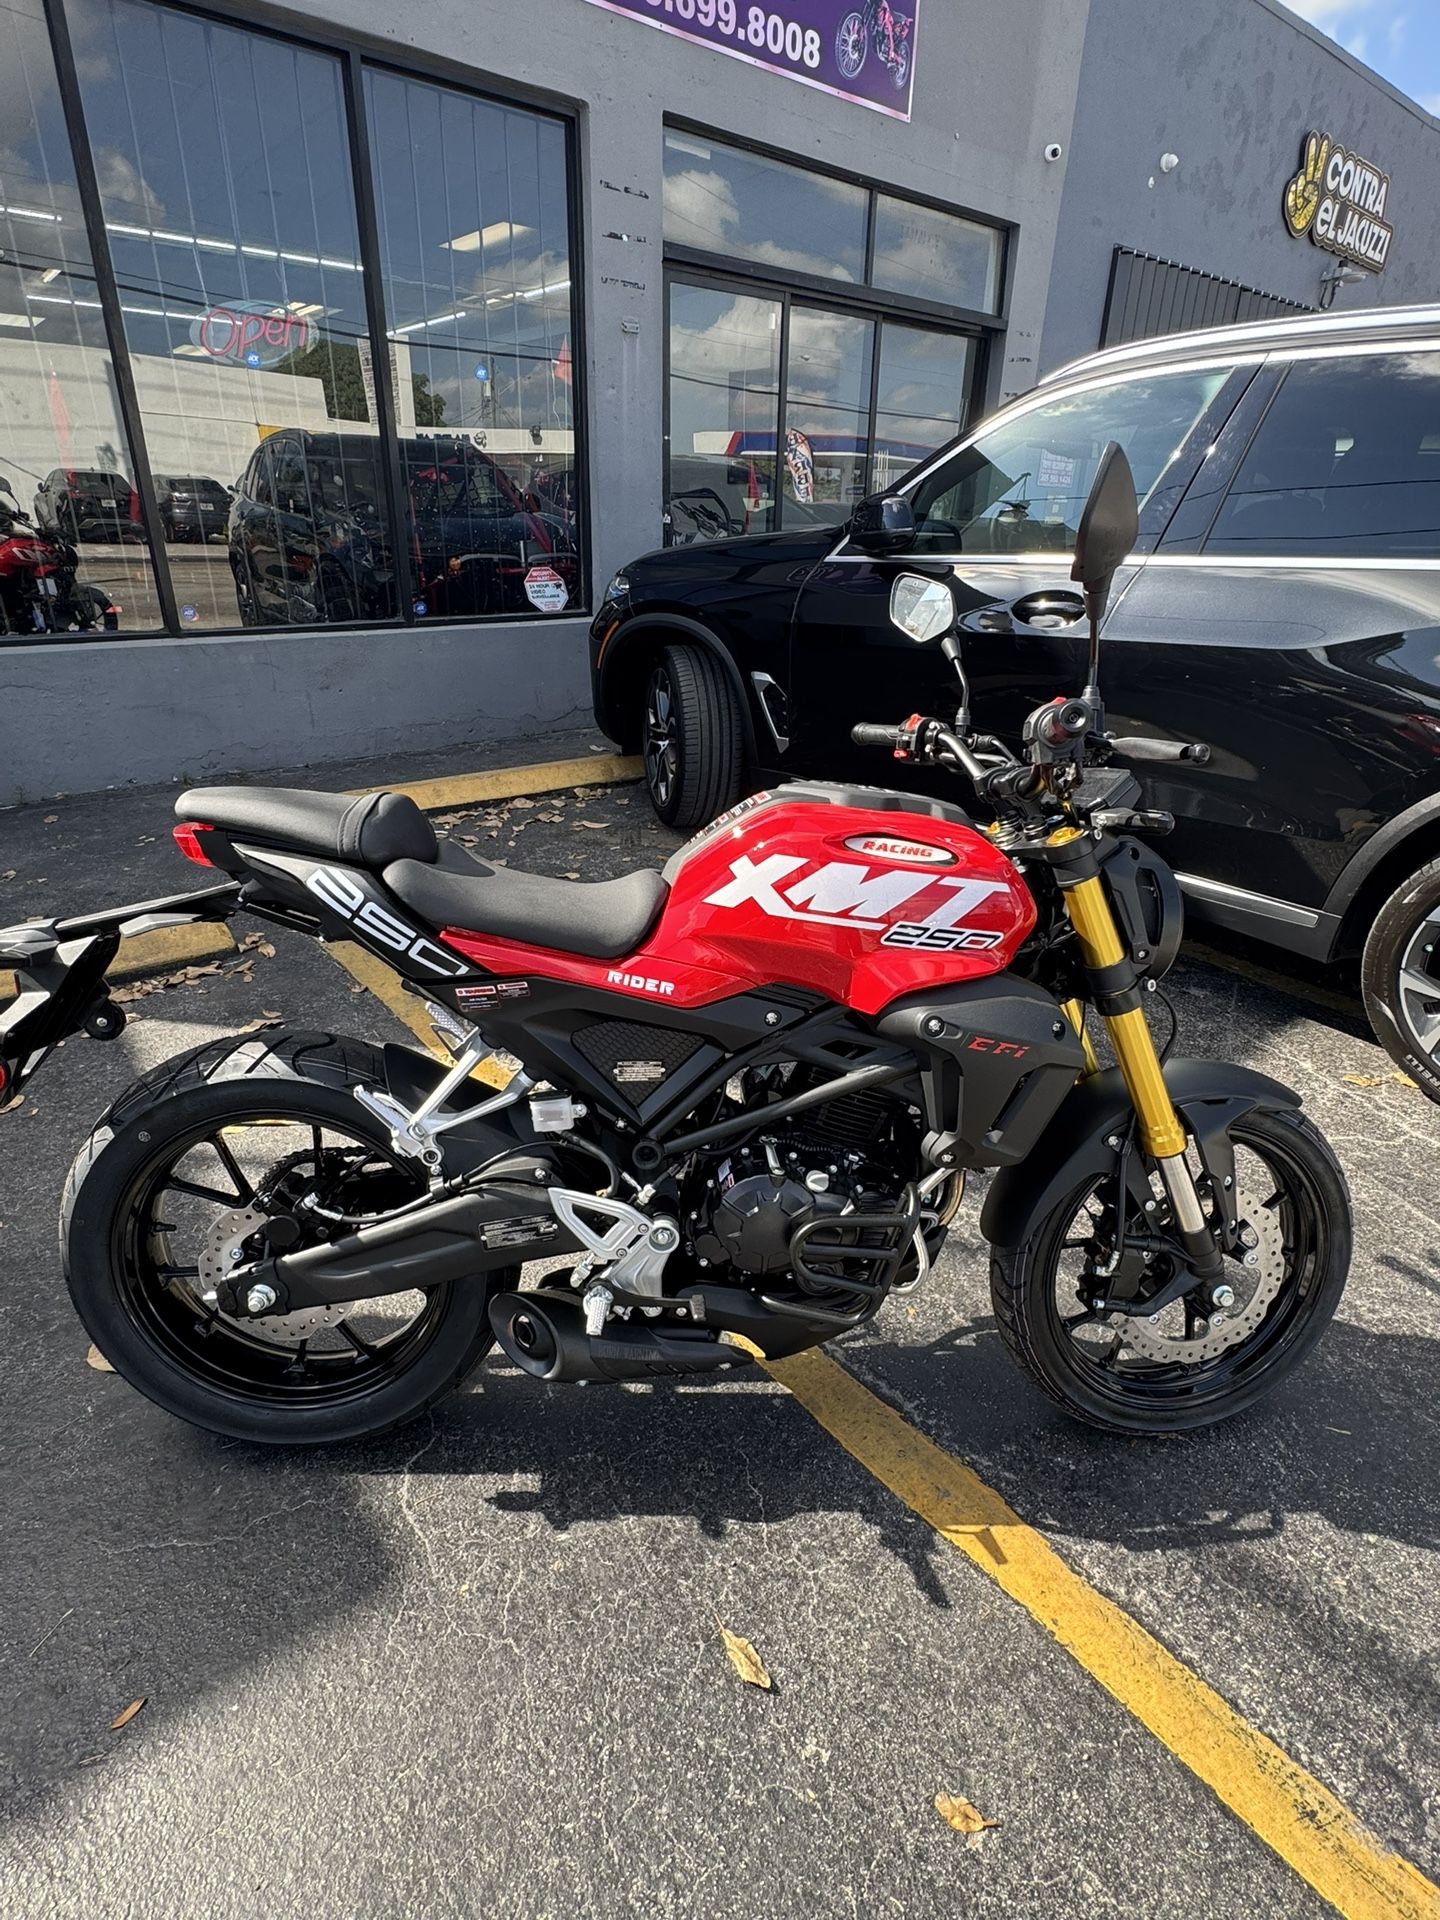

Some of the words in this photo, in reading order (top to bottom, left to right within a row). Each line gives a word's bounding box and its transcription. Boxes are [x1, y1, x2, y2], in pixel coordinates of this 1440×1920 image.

[1326, 152, 1388, 218] CONTRA
[1337, 210, 1392, 264] JACUZZI
[201, 308, 307, 358] Open
[701, 853, 1009, 930] XMT
[306, 867, 470, 976] 250
[883, 922, 1005, 952] 250
[607, 970, 675, 996] RIDER
[1405, 1054, 1440, 1089] RELLI
